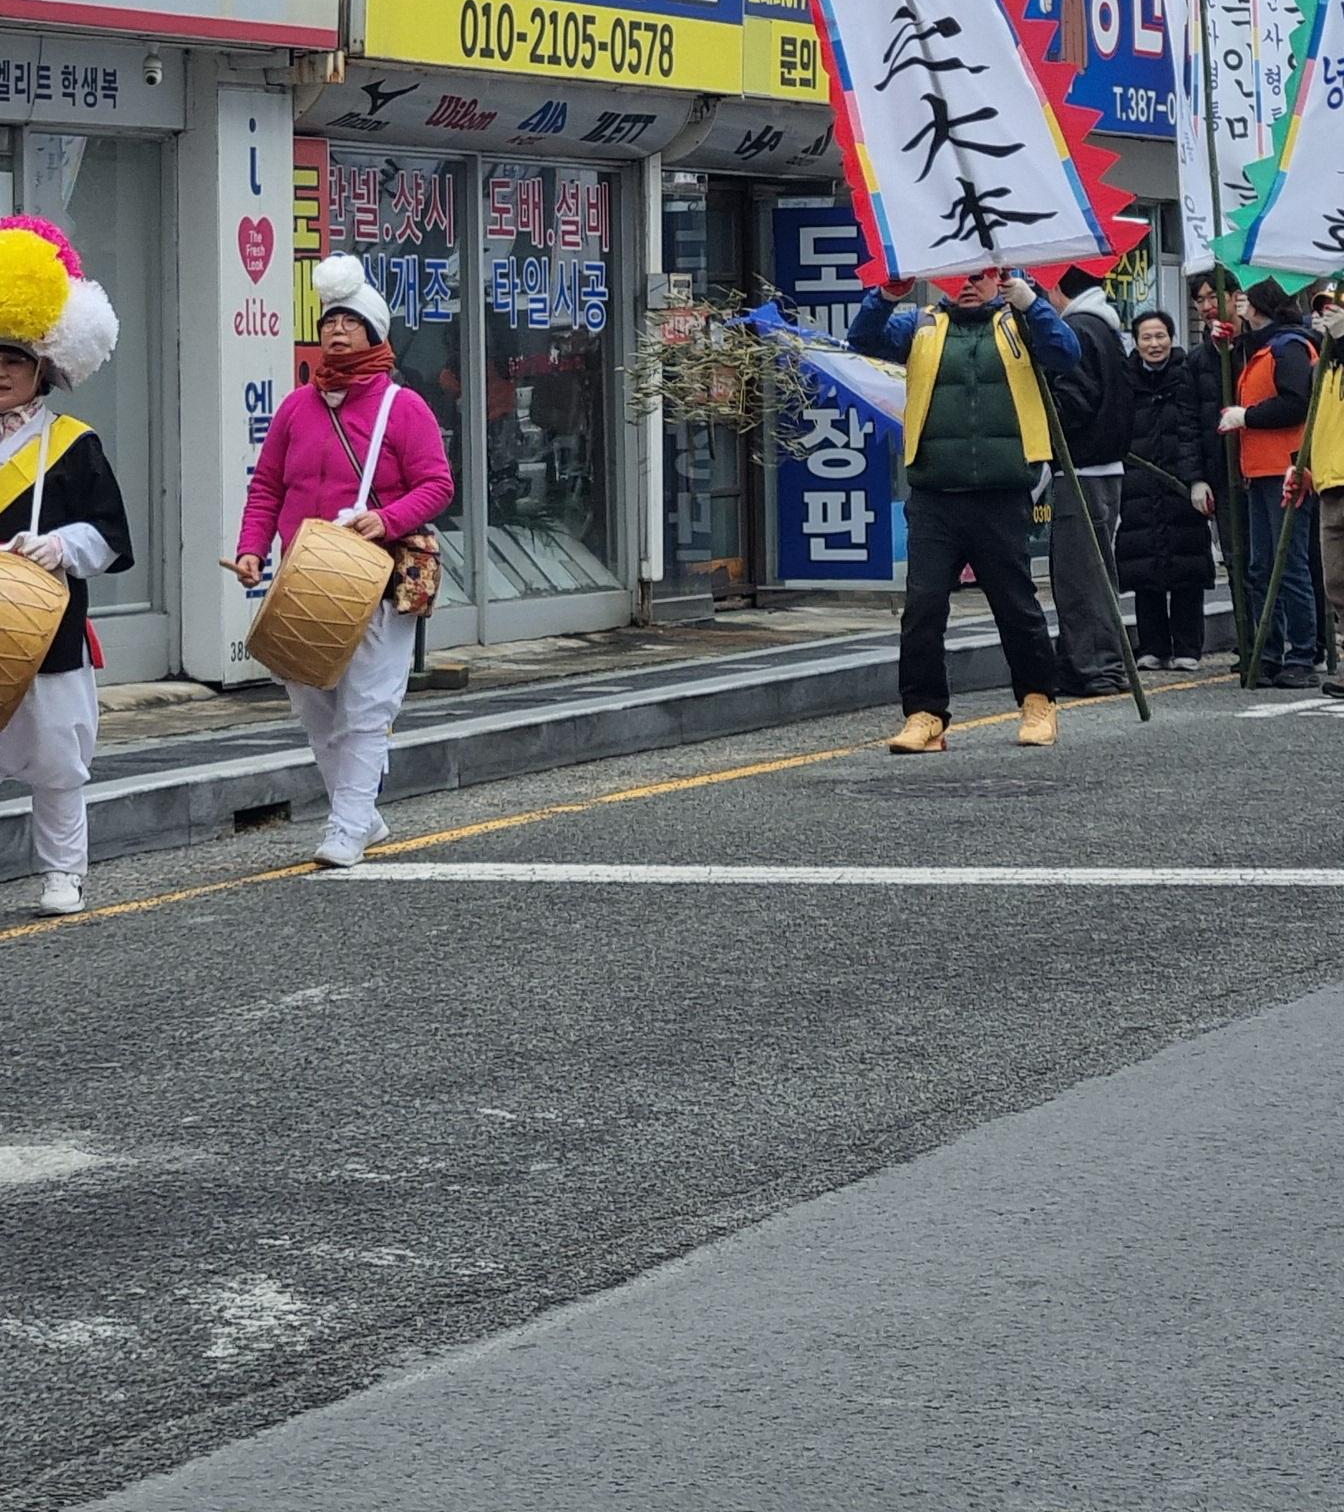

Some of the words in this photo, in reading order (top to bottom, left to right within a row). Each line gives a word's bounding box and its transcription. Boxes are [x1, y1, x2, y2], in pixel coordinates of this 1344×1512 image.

[460, 0, 675, 79] 010-2105-0578
[781, 35, 817, 90] 문의
[60, 64, 120, 110] 학생복
[424, 94, 498, 132] Wilson
[579, 111, 658, 145] ZETT
[491, 256, 609, 332] 타일시공
[233, 298, 280, 338] elite
